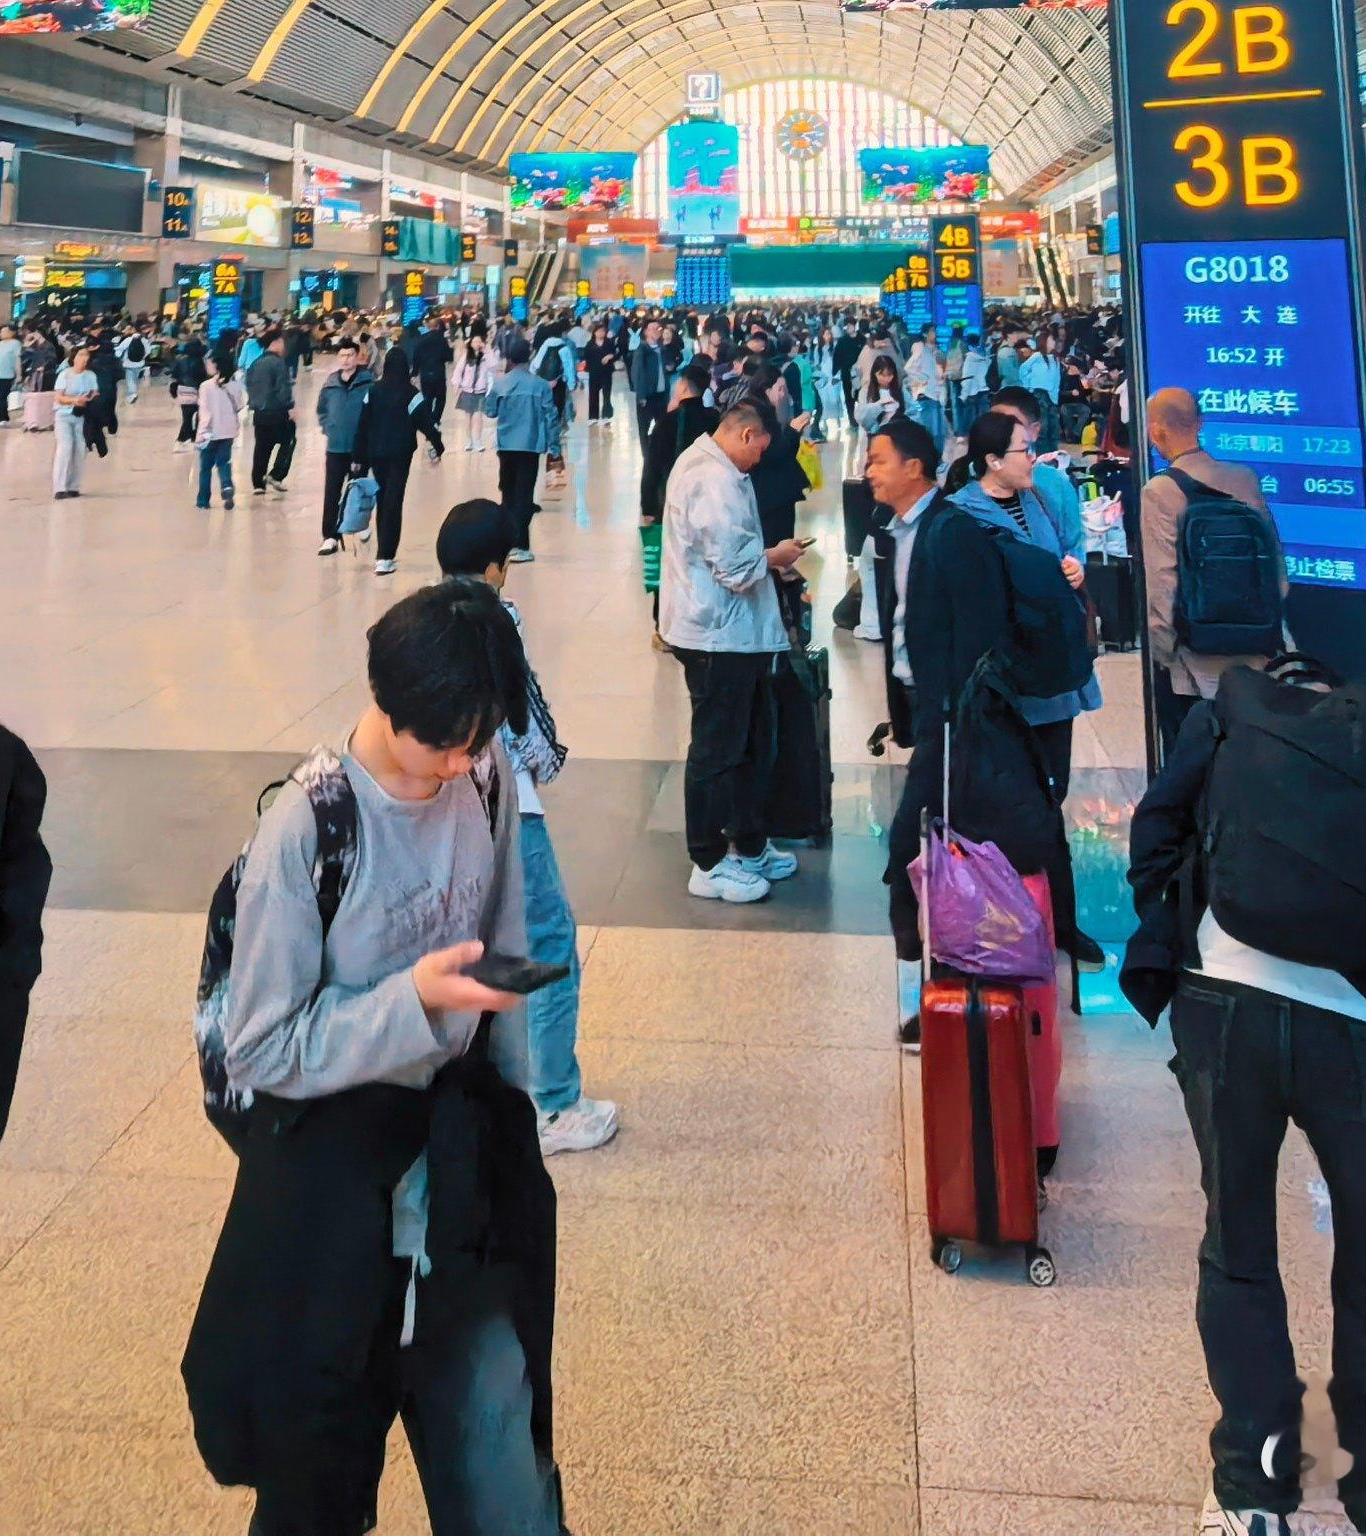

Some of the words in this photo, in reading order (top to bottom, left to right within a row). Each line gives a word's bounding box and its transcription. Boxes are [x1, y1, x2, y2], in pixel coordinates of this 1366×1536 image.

[1173, 125, 1299, 207] 3B
[939, 224, 970, 247] 4B
[941, 255, 970, 278] 5B
[1185, 255, 1289, 283] G8018
[1206, 347, 1257, 363] 16:52
[1264, 348, 1285, 366] 开
[1198, 388, 1299, 416] 在此候车
[1215, 433, 1283, 453] 北京朝阳
[1303, 438, 1351, 454] 17:23
[1304, 478, 1354, 495] 06:55
